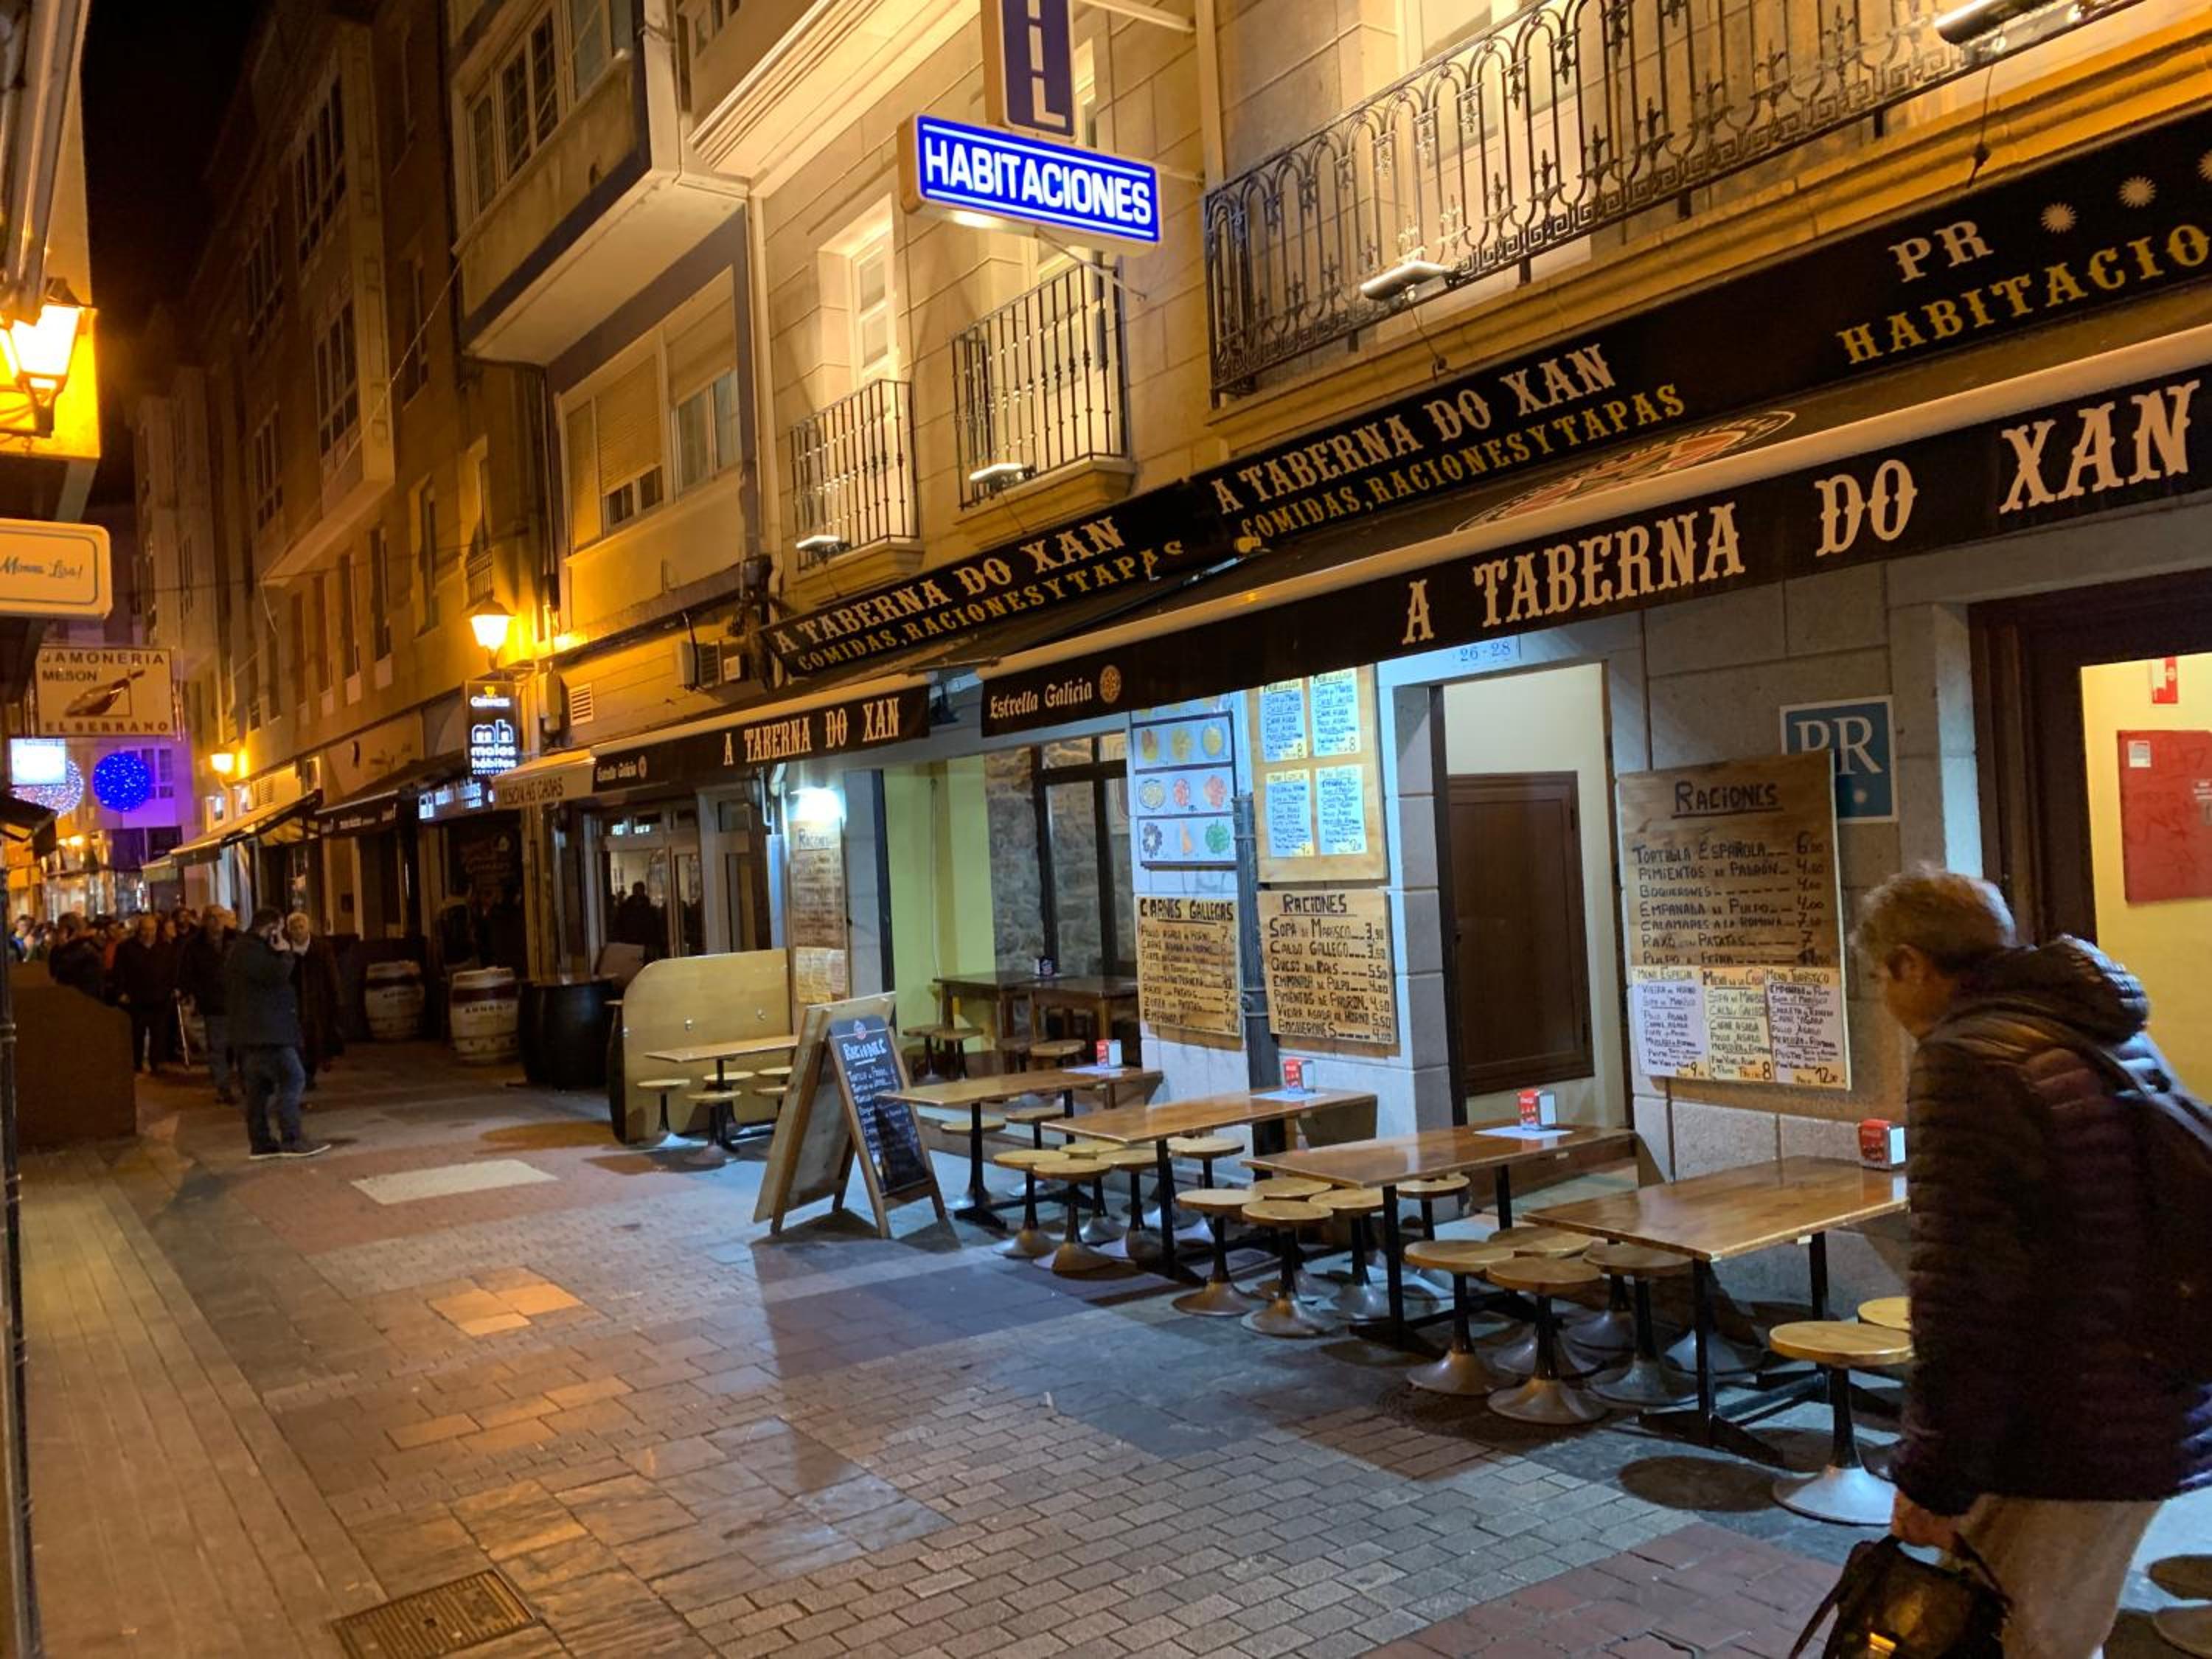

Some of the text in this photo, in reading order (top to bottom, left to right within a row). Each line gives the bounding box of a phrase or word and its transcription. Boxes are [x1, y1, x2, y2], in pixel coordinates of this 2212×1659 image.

[925, 136, 1152, 225] HABITACIONES
[1888, 220, 1994, 283] PR
[1835, 223, 2211, 365] HABITACIO
[1210, 342, 1617, 514] A TABERNA DO XAN
[1402, 379, 2202, 645] A TABERNA DO XAN
[773, 515, 1124, 654] A TABERNA DO XAN
[42, 652, 165, 664] JAMONERIA
[42, 669, 97, 682] MESON
[45, 722, 169, 733] EL SERRANO
[723, 696, 900, 766] A TABERNA DO XAN
[990, 677, 1093, 720] Estrella Galicia
[1793, 715, 1883, 775] PR
